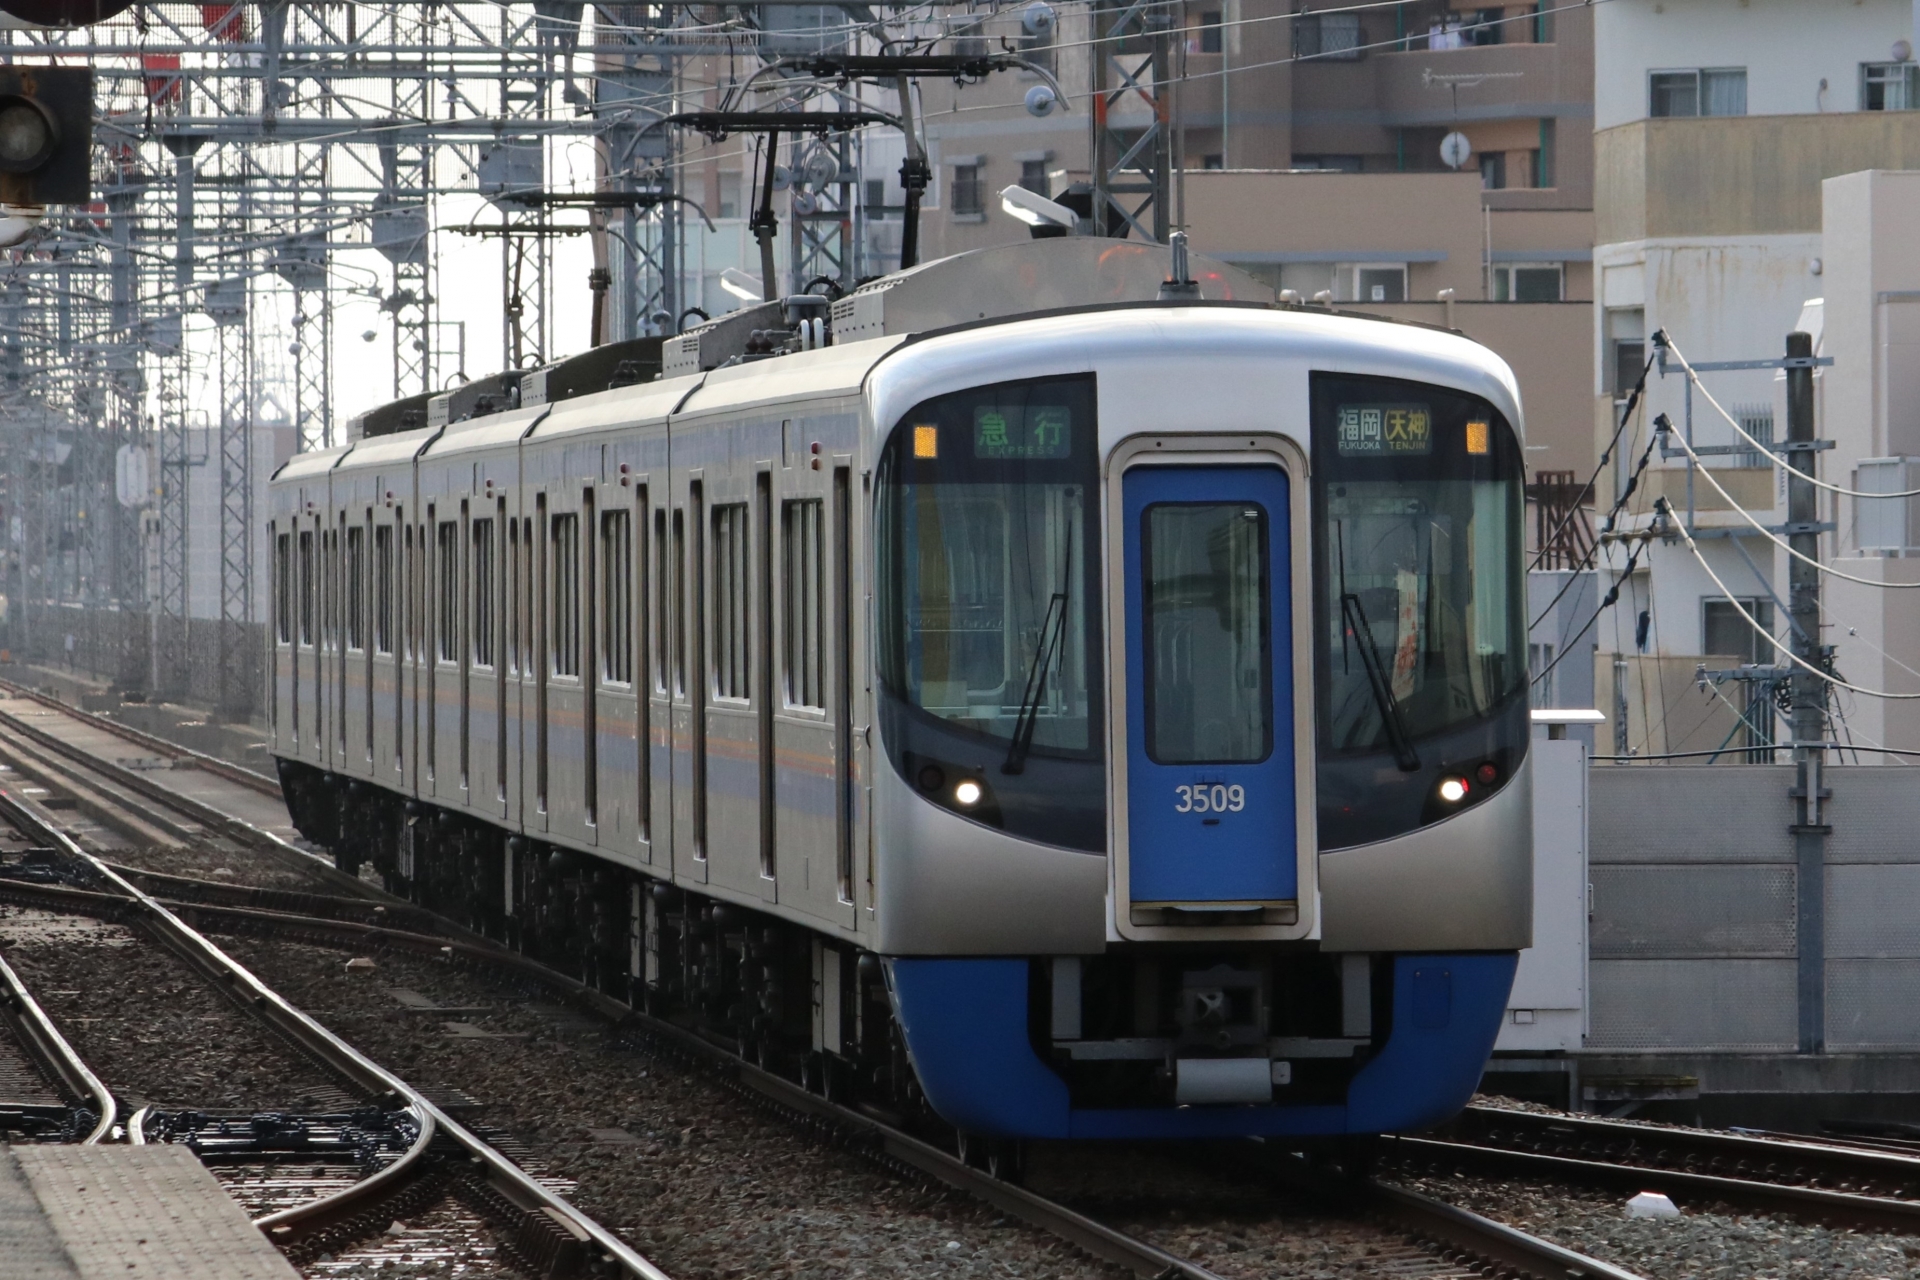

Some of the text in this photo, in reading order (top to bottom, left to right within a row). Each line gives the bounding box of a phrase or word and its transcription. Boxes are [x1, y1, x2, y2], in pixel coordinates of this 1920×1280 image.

[978, 412, 1064, 446] 急行
[987, 446, 1056, 456] EXPRESS
[1338, 441, 1427, 450] FUKUOKA TENJIN
[1175, 784, 1246, 813] 3509
